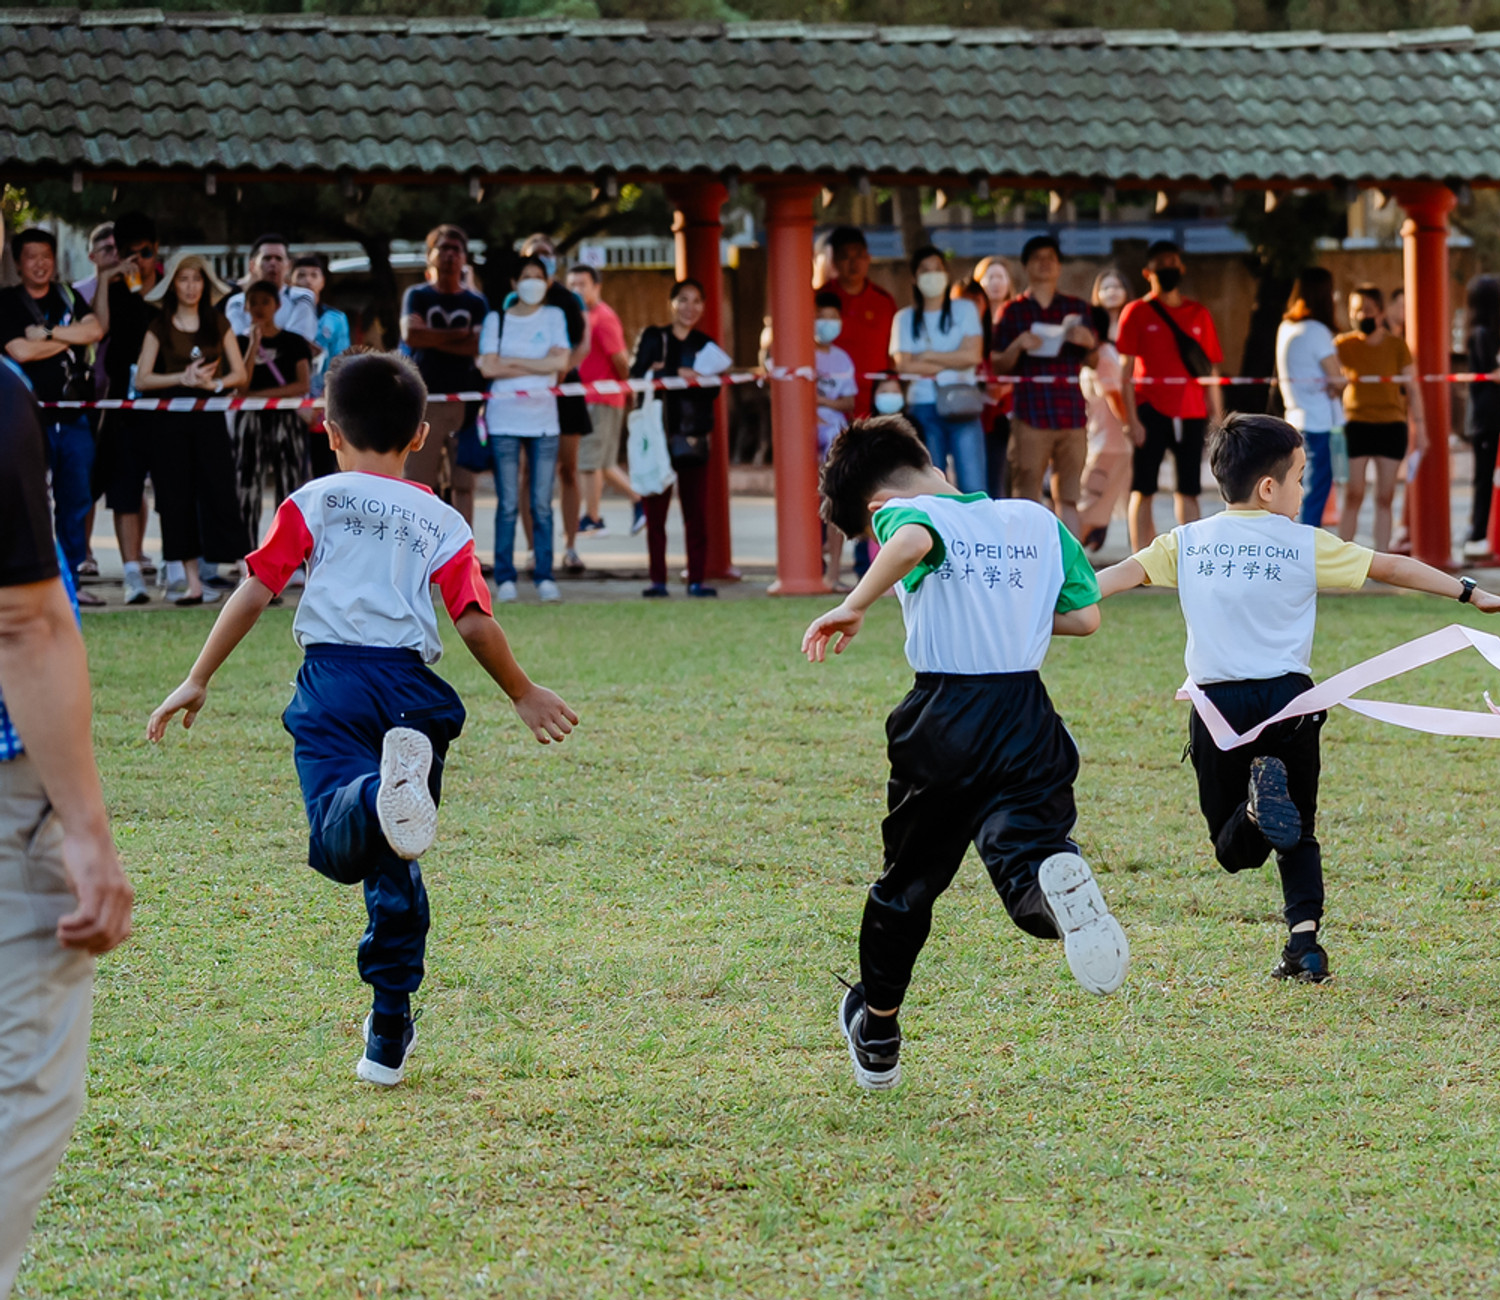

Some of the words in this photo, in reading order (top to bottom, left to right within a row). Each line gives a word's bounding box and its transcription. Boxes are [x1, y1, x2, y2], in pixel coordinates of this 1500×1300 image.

[326, 494, 358, 511] SJK
[361, 499, 387, 517] (C)
[390, 504, 416, 523] PEI
[343, 516, 430, 559] 培才学校
[974, 543, 1002, 560] PEI
[1006, 544, 1038, 560] CHAI
[1186, 543, 1212, 557] SJK
[1213, 543, 1235, 558] (C)
[1237, 544, 1262, 557] PEI
[1264, 545, 1300, 561] CHAI
[1196, 559, 1283, 582] 培才学校
